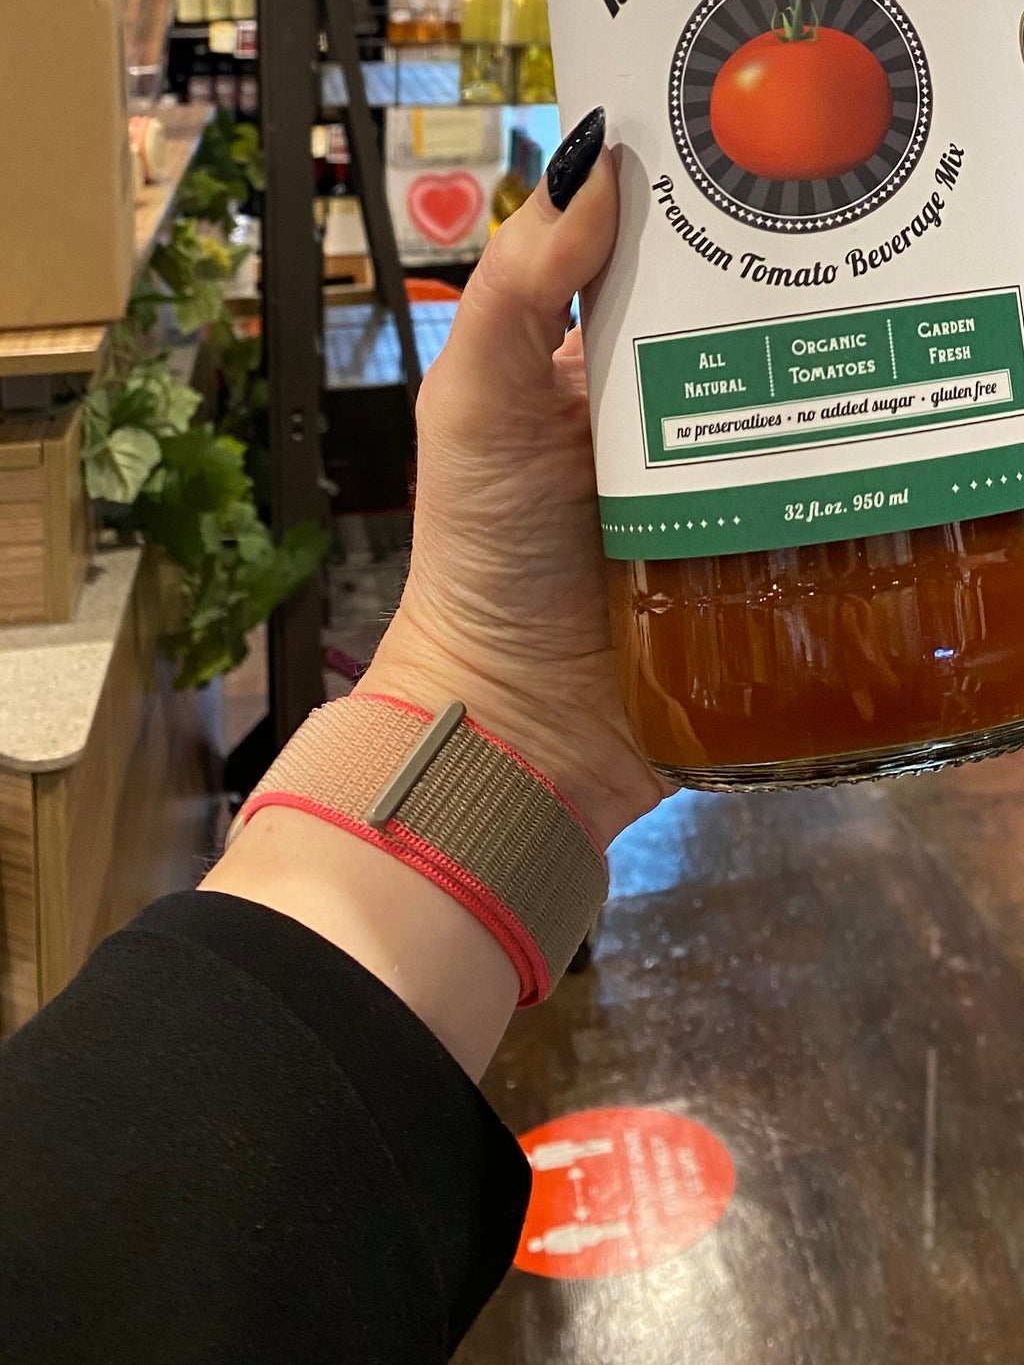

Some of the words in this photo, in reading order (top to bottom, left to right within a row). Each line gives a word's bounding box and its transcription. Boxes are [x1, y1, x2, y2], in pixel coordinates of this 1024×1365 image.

[651, 174, 733, 271] Premium
[740, 252, 839, 287] Tomato
[845, 191, 945, 277] Beverage
[934, 143, 965, 191] Mix
[917, 318, 975, 338] GARDEN
[791, 333, 868, 356] ORGANIC
[928, 346, 971, 364] FRESH
[788, 359, 876, 384] TOMATOES
[684, 378, 747, 399] NATURAL
[677, 426, 691, 439] no
[694, 412, 782, 442] preservatives
[797, 408, 816, 423] no
[820, 396, 869, 420] added
[871, 392, 916, 414] sugar
[930, 385, 973, 408] gluten
[971, 381, 998, 402] free
[784, 502, 805, 521] 32
[852, 490, 885, 511] 950
[888, 487, 909, 505] ml
